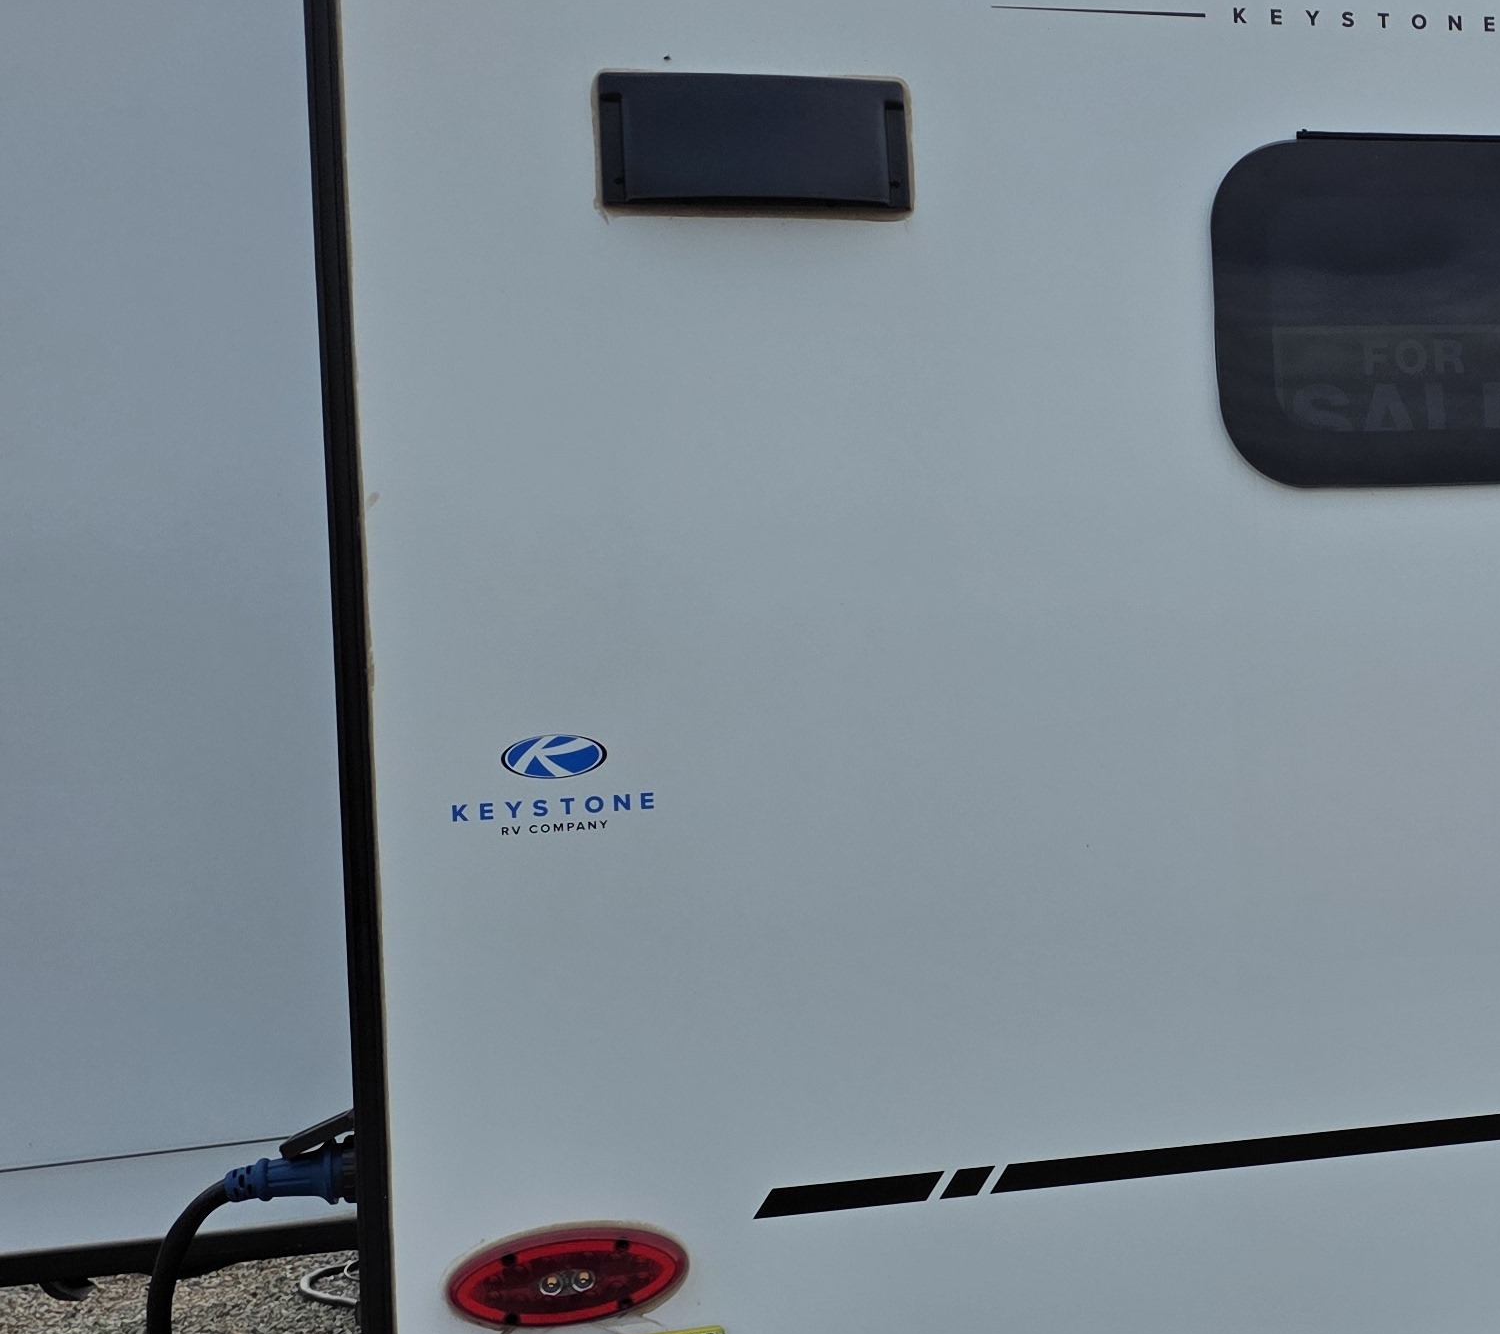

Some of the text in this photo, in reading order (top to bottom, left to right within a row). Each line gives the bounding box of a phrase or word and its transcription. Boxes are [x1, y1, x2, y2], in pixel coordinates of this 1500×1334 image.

[1232, 7, 1496, 33] KEYSTONE
[1362, 338, 1466, 376] FOR
[451, 792, 655, 822] KEYSTONE
[501, 819, 609, 836] RV COMPANY
